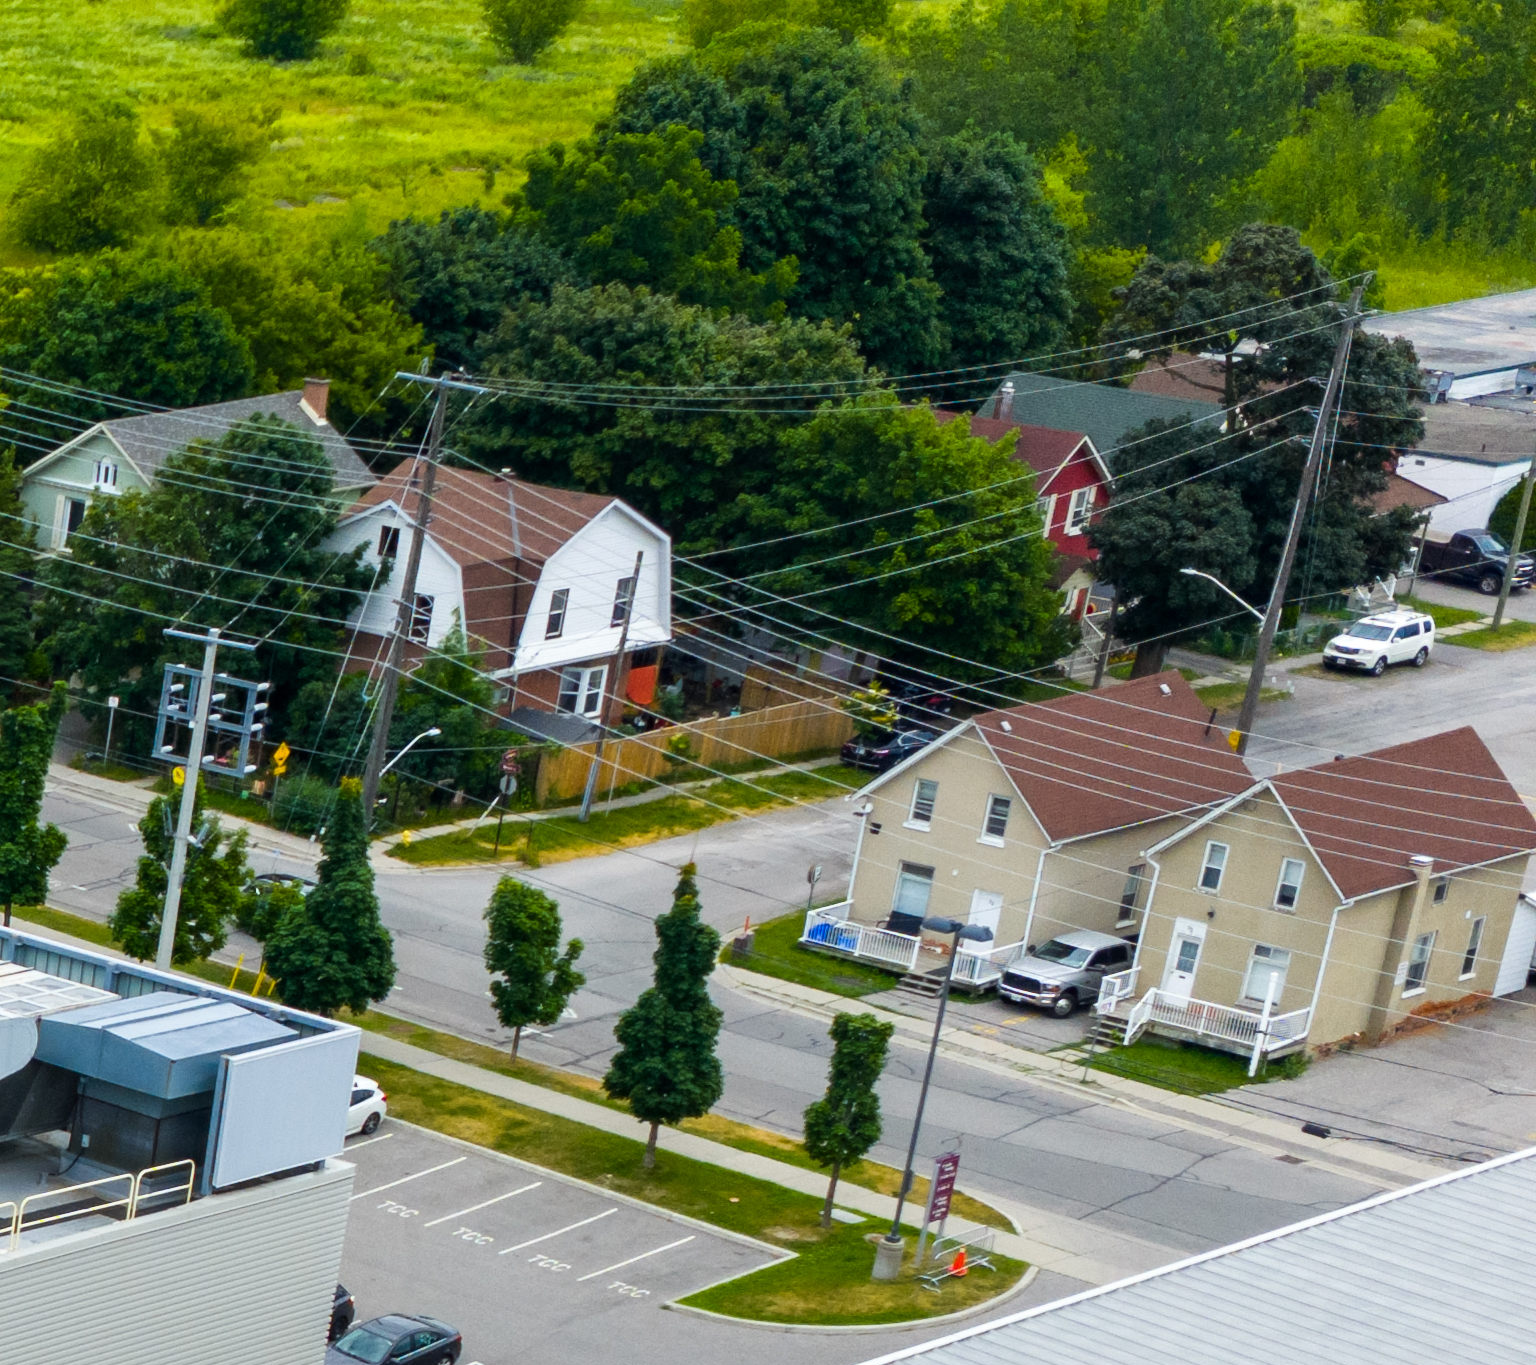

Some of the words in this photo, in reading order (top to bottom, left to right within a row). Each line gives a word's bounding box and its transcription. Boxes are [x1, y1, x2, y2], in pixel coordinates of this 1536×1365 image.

[376, 1200, 420, 1218] TCC
[452, 1226, 494, 1245] TCC
[528, 1253, 571, 1272] TCC
[607, 1280, 650, 1298] TCC
